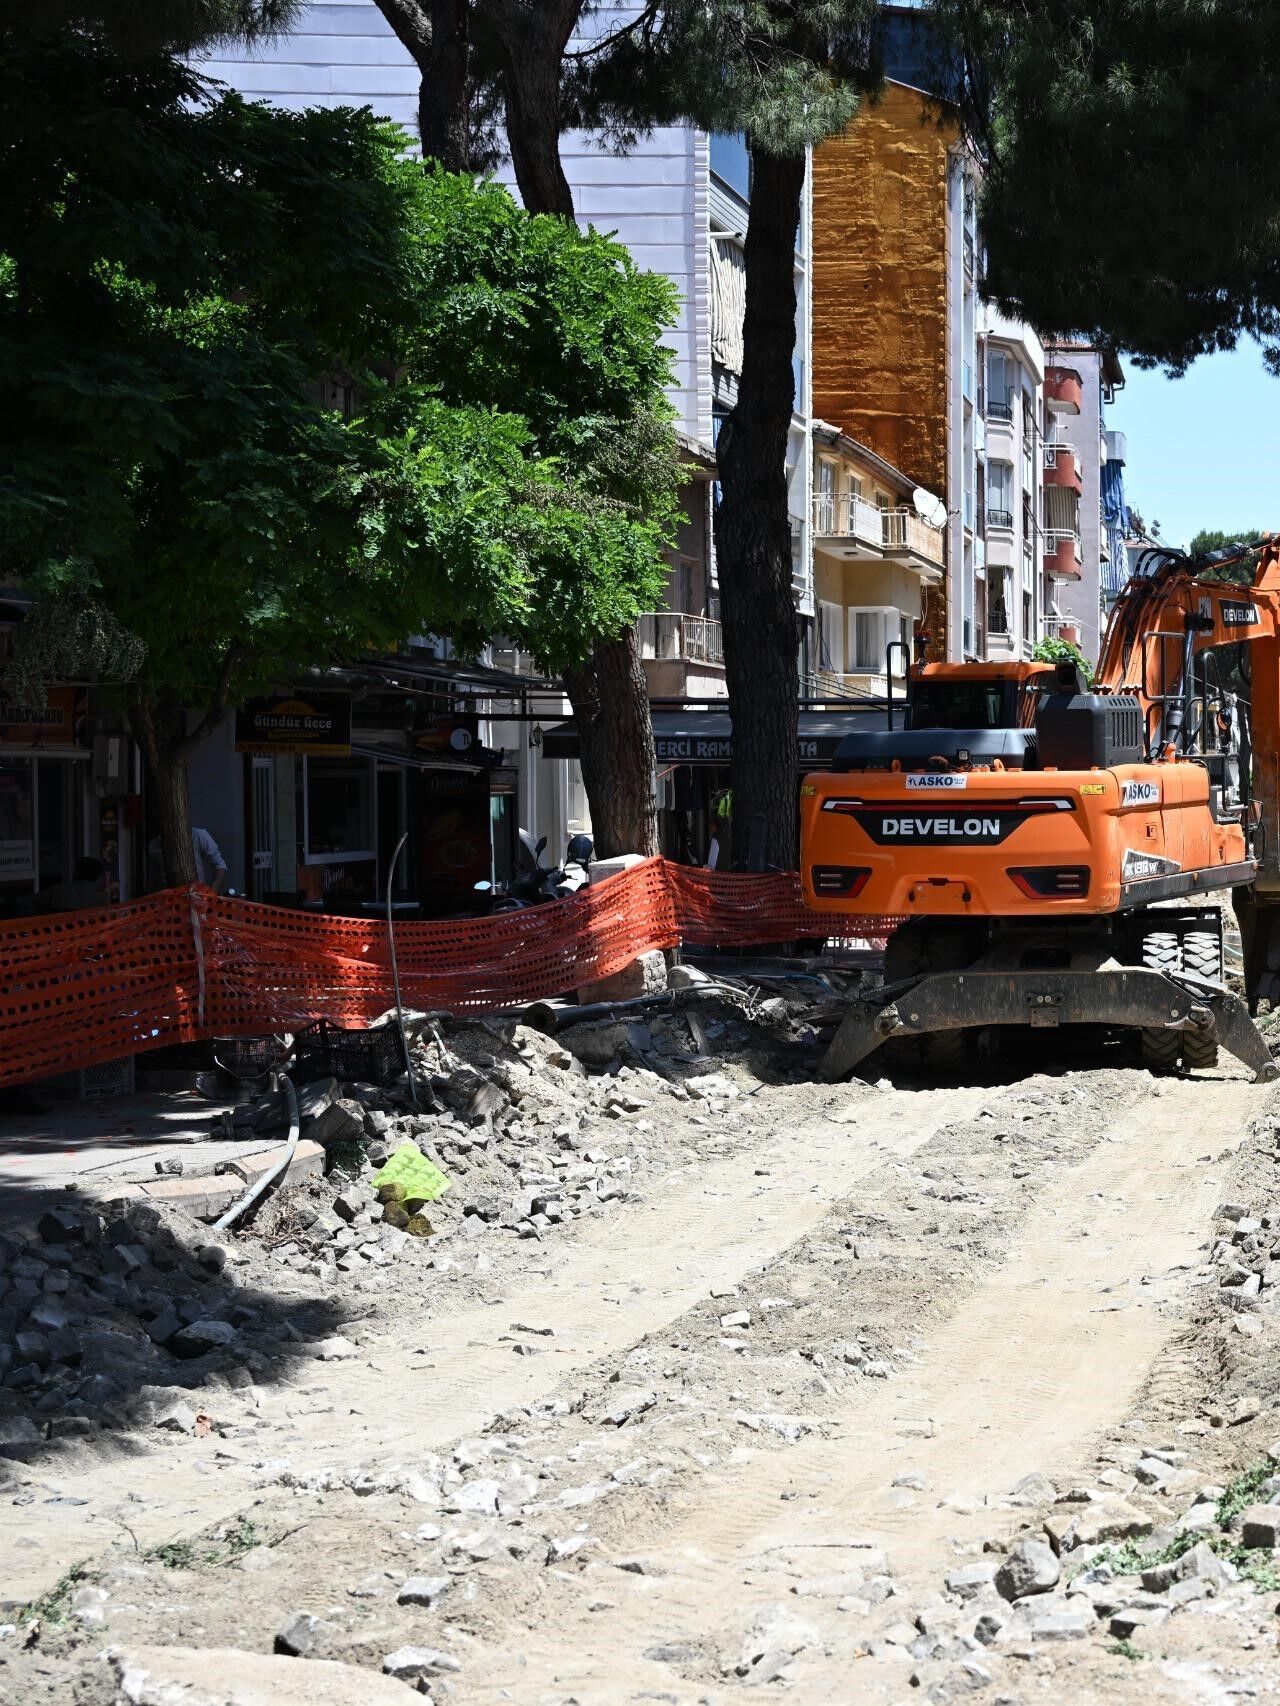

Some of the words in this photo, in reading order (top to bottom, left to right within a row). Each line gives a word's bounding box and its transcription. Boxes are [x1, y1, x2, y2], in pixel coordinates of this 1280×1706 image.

[1223, 608, 1255, 622] DEVELON
[254, 714, 301, 728] Gündüz
[696, 740, 733, 758] RAM
[918, 776, 954, 786] ASKO
[1128, 783, 1151, 800] ASKO
[882, 818, 1001, 836] DEVELON
